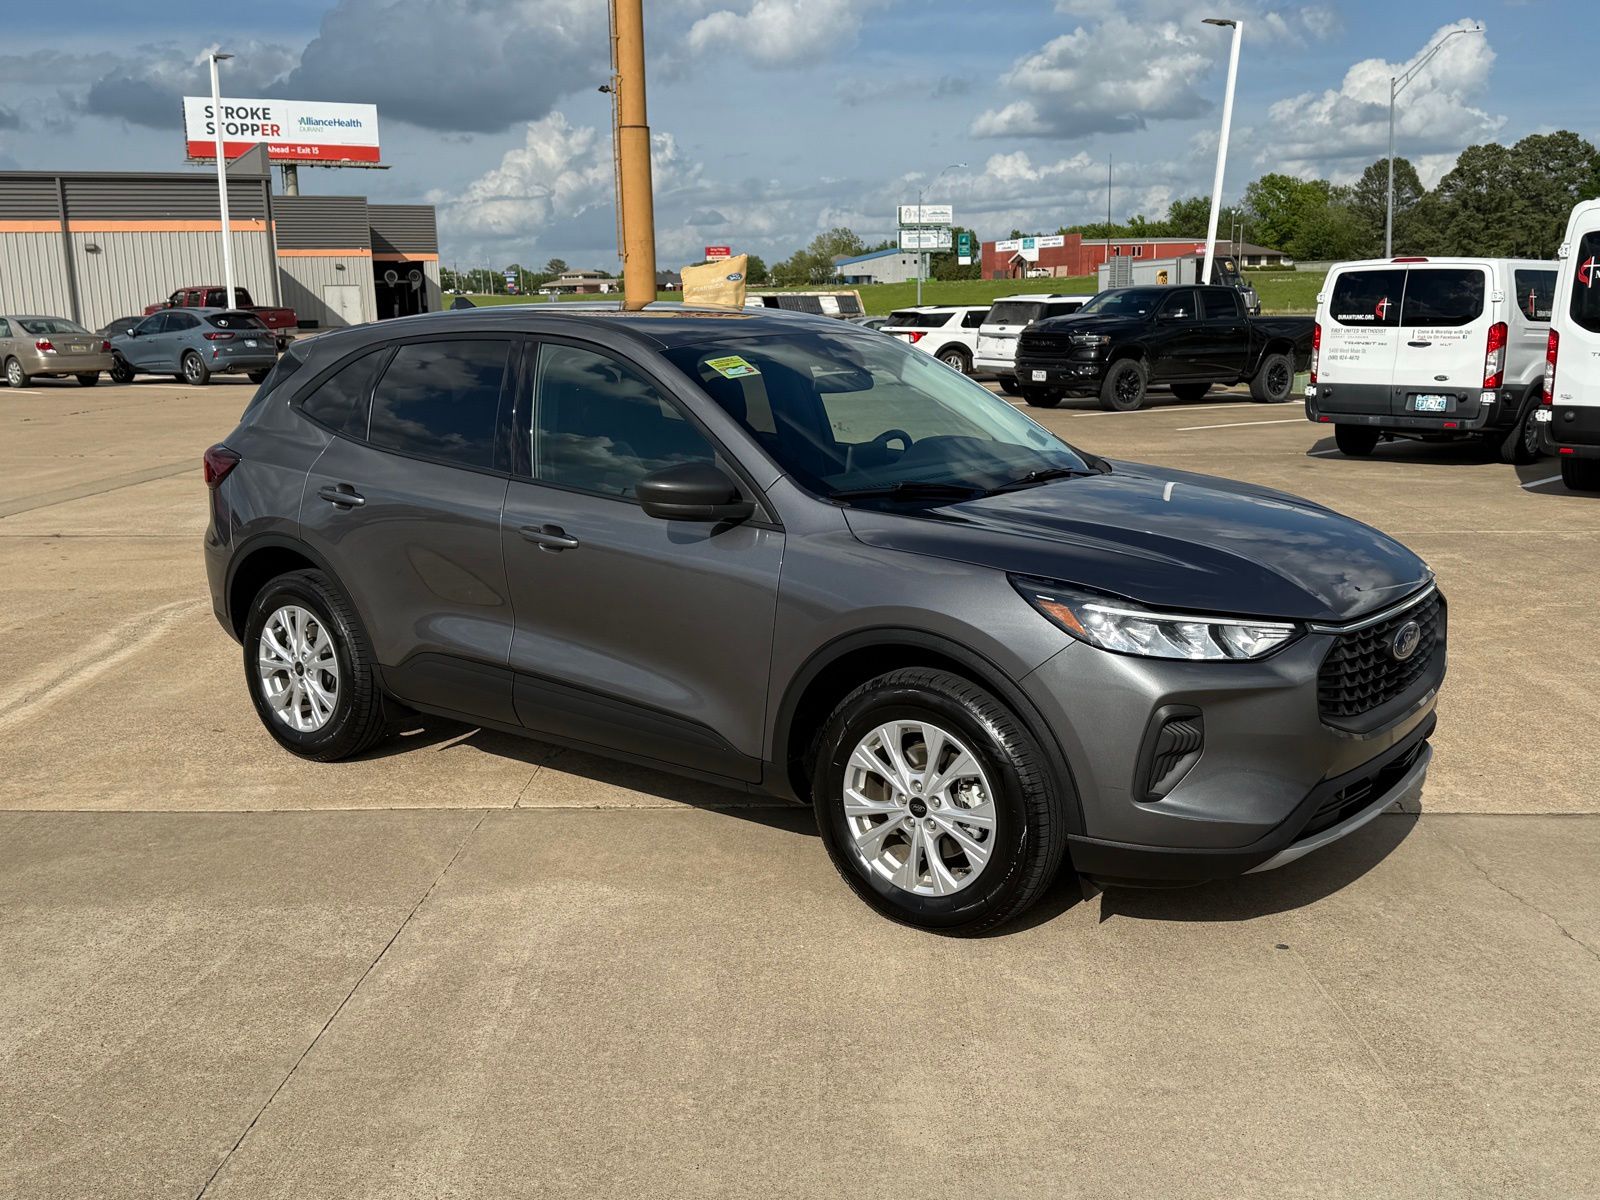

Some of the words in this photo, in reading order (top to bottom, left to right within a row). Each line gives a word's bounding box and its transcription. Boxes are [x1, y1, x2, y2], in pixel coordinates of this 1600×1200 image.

[204, 105, 271, 120] SROKE
[299, 116, 362, 128] AllianceHealth
[206, 122, 280, 136] SOPPER
[297, 146, 311, 154] Exit
